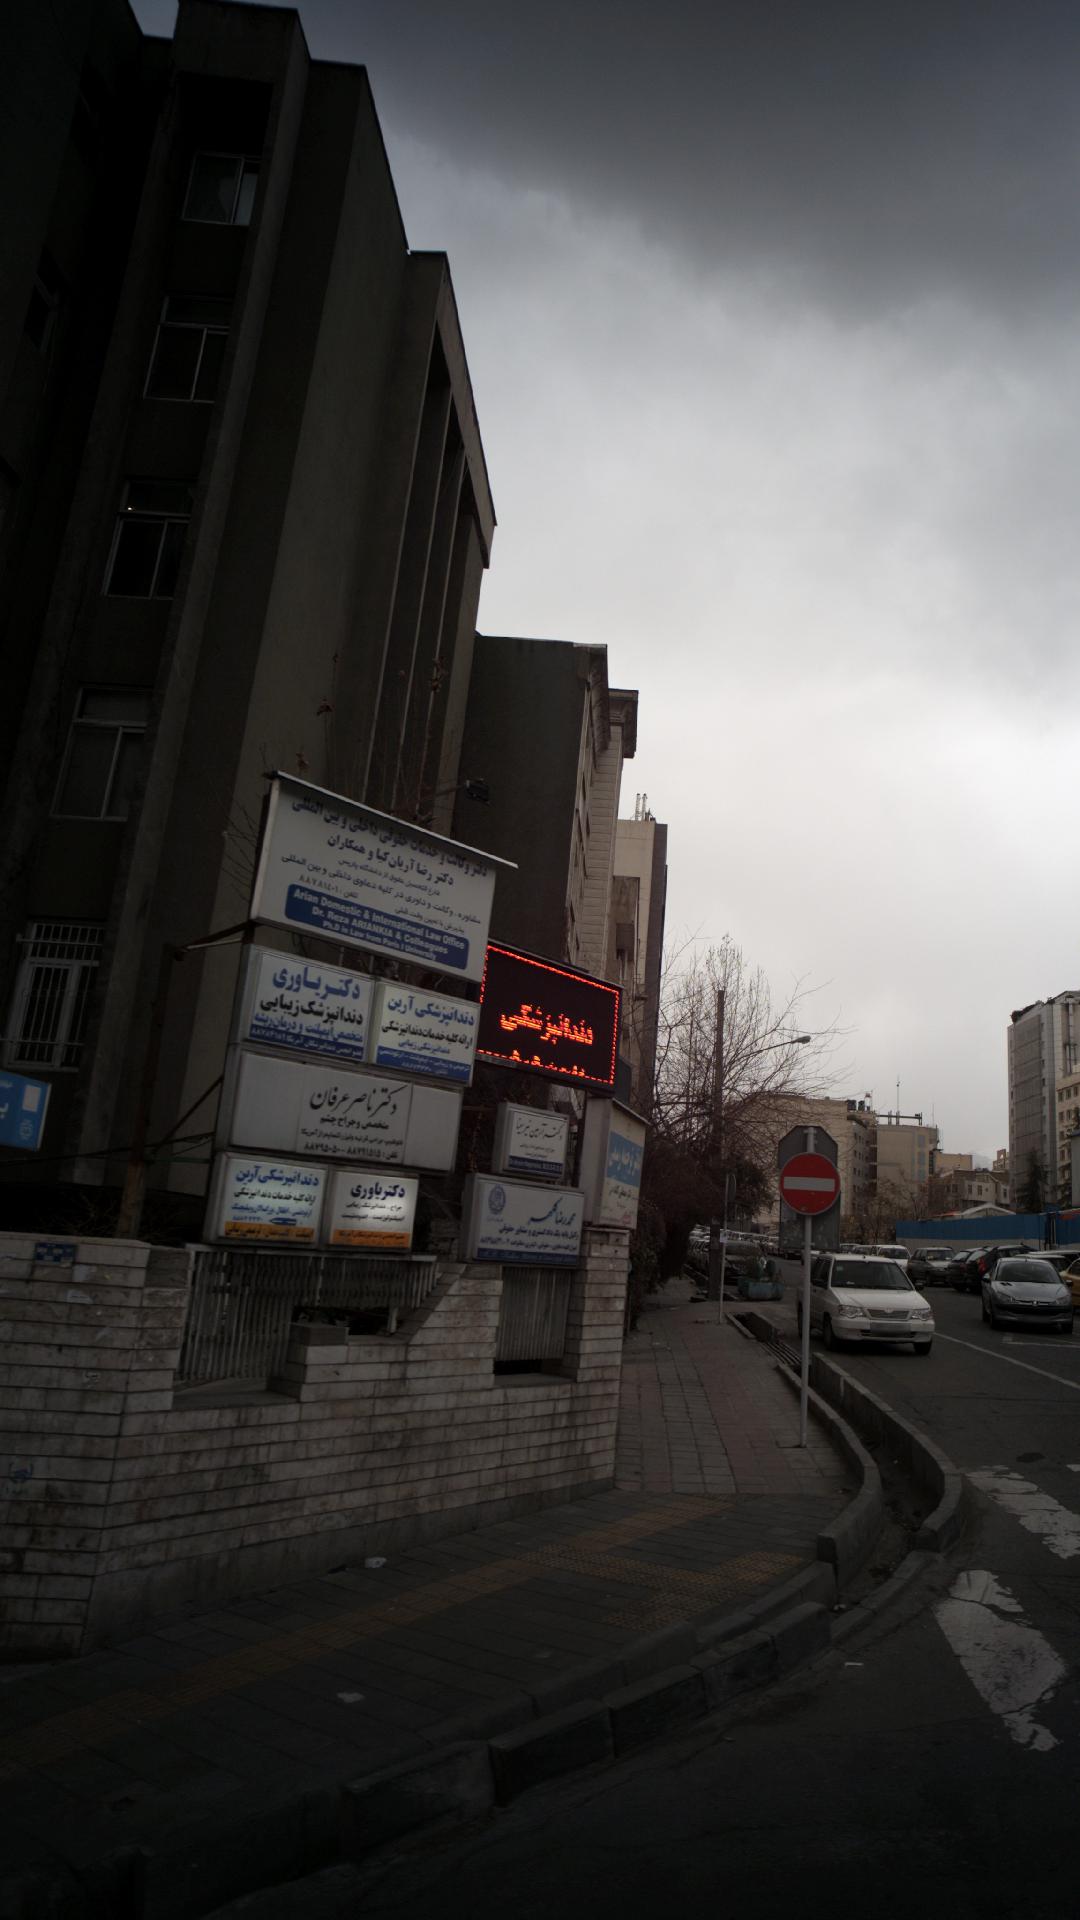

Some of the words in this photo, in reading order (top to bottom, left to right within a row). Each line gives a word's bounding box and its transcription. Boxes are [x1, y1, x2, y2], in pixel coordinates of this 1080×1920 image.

[327, 835, 365, 854] همکاران
[281, 854, 307, 865] المللی
[376, 847, 390, 864] کیا
[388, 855, 415, 873] آریان
[416, 862, 432, 882] رضا
[433, 872, 454, 886] دکتر
[294, 887, 318, 903] Arian
[321, 896, 361, 917] Domestic
[364, 909, 370, 919] &
[372, 912, 424, 936] International
[425, 928, 442, 941] Law
[442, 934, 464, 950] Office
[312, 905, 324, 917] Dr.
[327, 910, 349, 924] Reza
[352, 918, 393, 937] ARIANKIA
[404, 934, 448, 954] Colleagues
[349, 927, 365, 938] Law
[272, 966, 321, 996] یاوری
[320, 978, 360, 1000] دکتر
[260, 994, 300, 1017] زیبایی
[301, 1000, 363, 1025] دندانپزشک
[387, 995, 416, 1015] آرین
[414, 1002, 474, 1026] دندانپزشکی
[381, 1020, 423, 1036] دندانپزشکی
[500, 1004, 593, 1045] دندانپزشکی
[308, 1086, 348, 1113] عرفان
[342, 1088, 377, 1116] ناصر
[368, 1084, 407, 1117] دکتر
[320, 1114, 337, 1124] چشم
[337, 1116, 356, 1128] جراح
[361, 1122, 389, 1130] متخصص
[235, 1165, 261, 1183] آرین
[257, 1167, 319, 1187] دندانپزشکی
[350, 1182, 382, 1200] یاوری
[380, 1184, 405, 1201] دکتر
